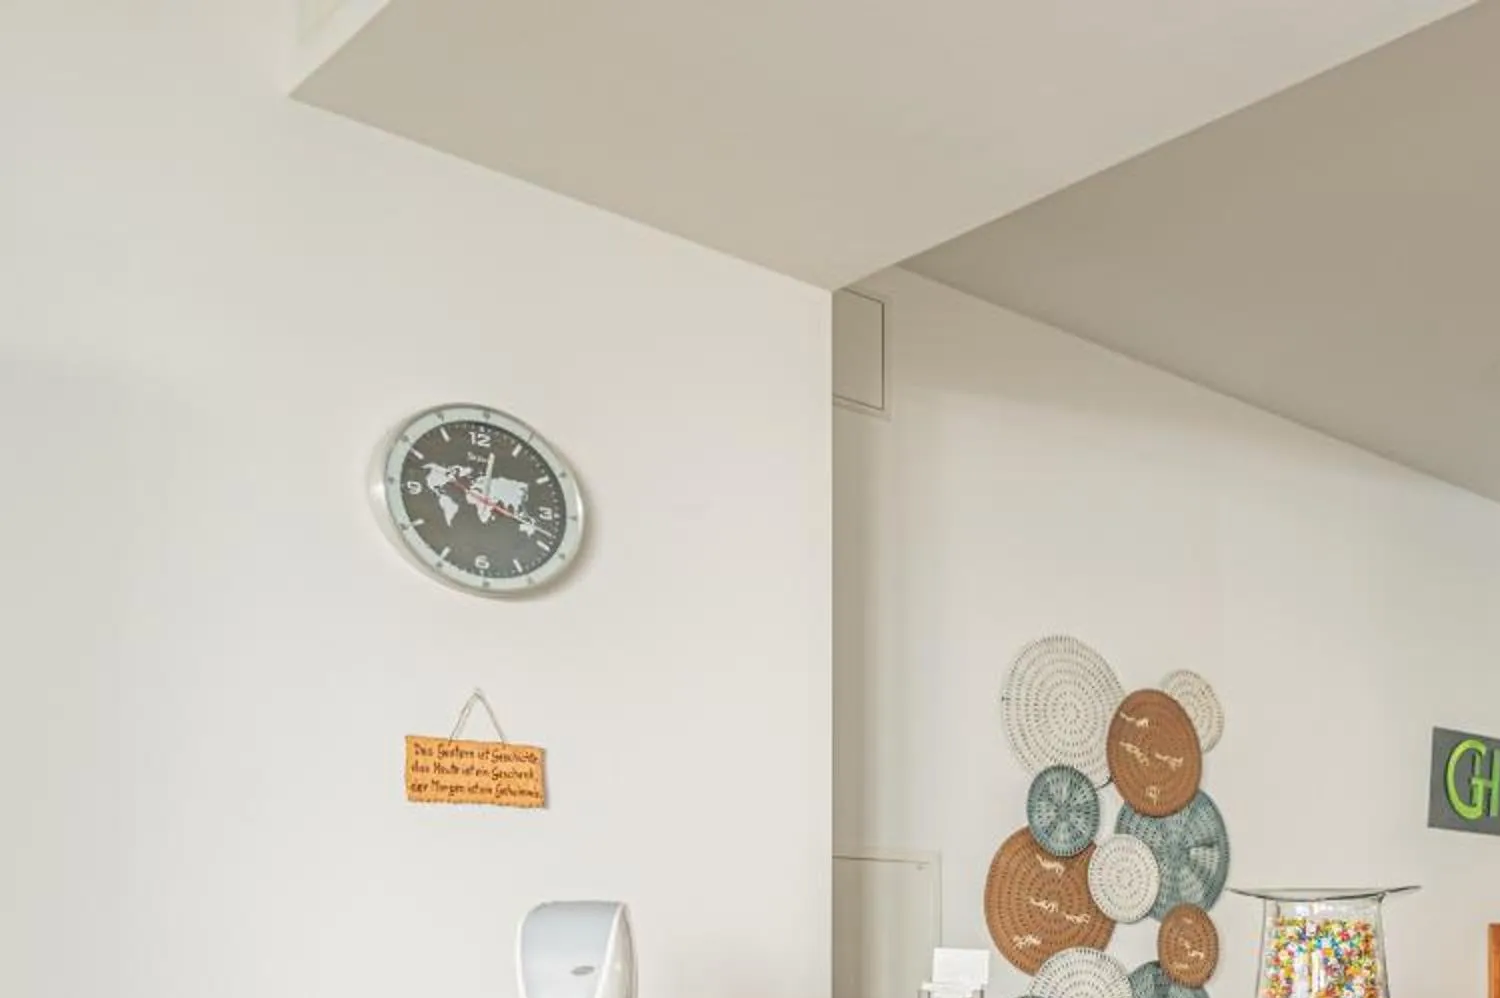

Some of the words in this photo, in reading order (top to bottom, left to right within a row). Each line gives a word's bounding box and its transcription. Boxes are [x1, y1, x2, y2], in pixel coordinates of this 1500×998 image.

[468, 431, 492, 447] 12
[407, 481, 422, 495] 9
[539, 506, 553, 520] 3
[474, 555, 490, 570] 6
